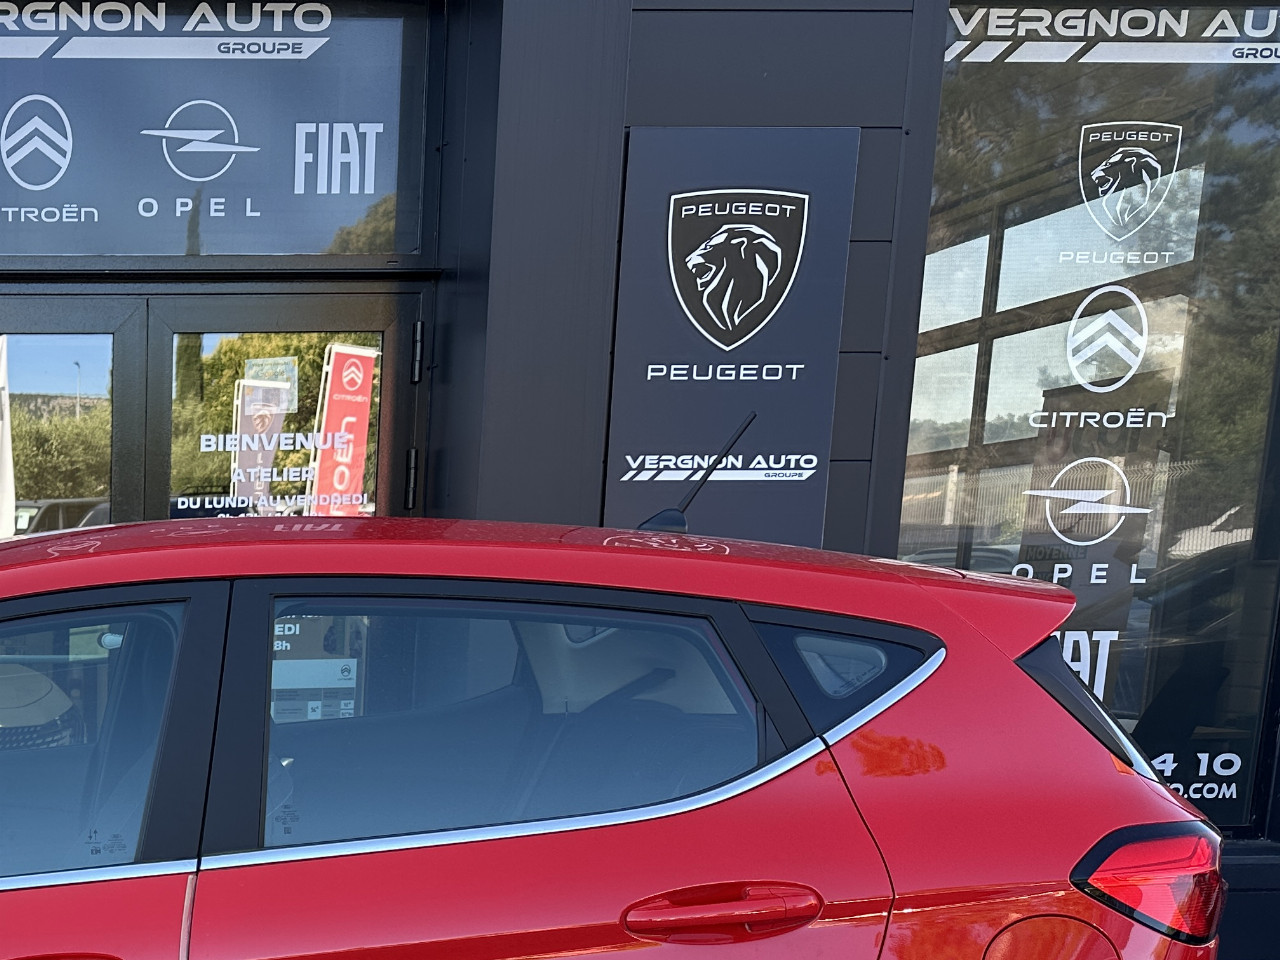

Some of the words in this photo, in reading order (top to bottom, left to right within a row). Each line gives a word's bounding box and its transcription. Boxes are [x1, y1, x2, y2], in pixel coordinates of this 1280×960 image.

[182, 1, 333, 31] AUTO
[949, 8, 1189, 38] VERGNON
[1201, 8, 1280, 38] AU
[216, 42, 304, 55] GROUPE
[1088, 131, 1173, 144] PEUGEOT
[294, 122, 384, 195] FIAT
[137, 197, 261, 218] OPEL
[680, 203, 797, 219] PEUGEOT
[1058, 251, 1174, 264] PEUGEOT
[646, 364, 805, 381] PEUGEOT
[200, 432, 348, 452] BIENVENUE
[749, 454, 818, 469] AUTO
[231, 467, 315, 482] ATELIER
[177, 498, 201, 509] DU
[204, 496, 253, 508] LUNDI
[258, 496, 282, 507] AU
[285, 493, 368, 506] VENDREDI
[1196, 752, 1242, 776] 10
[1165, 782, 1237, 799] O.COM
